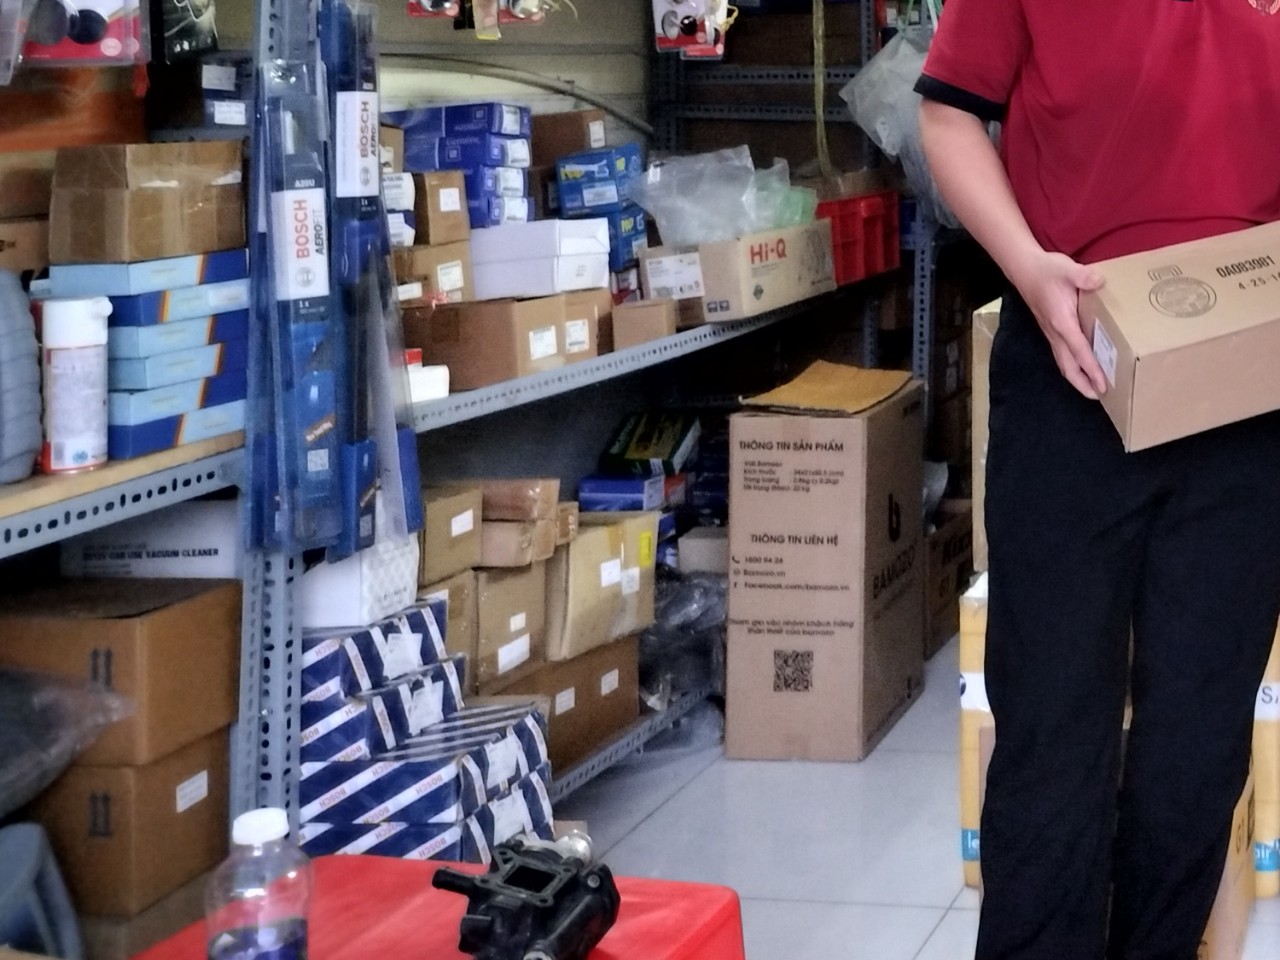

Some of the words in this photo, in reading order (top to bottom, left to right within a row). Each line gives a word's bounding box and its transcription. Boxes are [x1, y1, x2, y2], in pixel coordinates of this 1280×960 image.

[360, 101, 369, 158] BOSCH
[293, 199, 311, 259] BOSCH
[750, 238, 787, 264] Hi-Q
[740, 439, 774, 451] THÔNG
[776, 441, 790, 451] TIN
[792, 439, 812, 451] SẢN
[815, 438, 844, 451] PHẨM
[751, 533, 786, 544] THÔNG
[787, 534, 802, 544] TIN
[804, 534, 824, 545] LIÊN
[826, 534, 838, 547] HỆ
[146, 549, 179, 560] VACUUM
[182, 548, 219, 558] CLEANER
[416, 774, 443, 795] BOSCH
[319, 788, 347, 808] BOSCH
[418, 837, 447, 858] BOSCH
